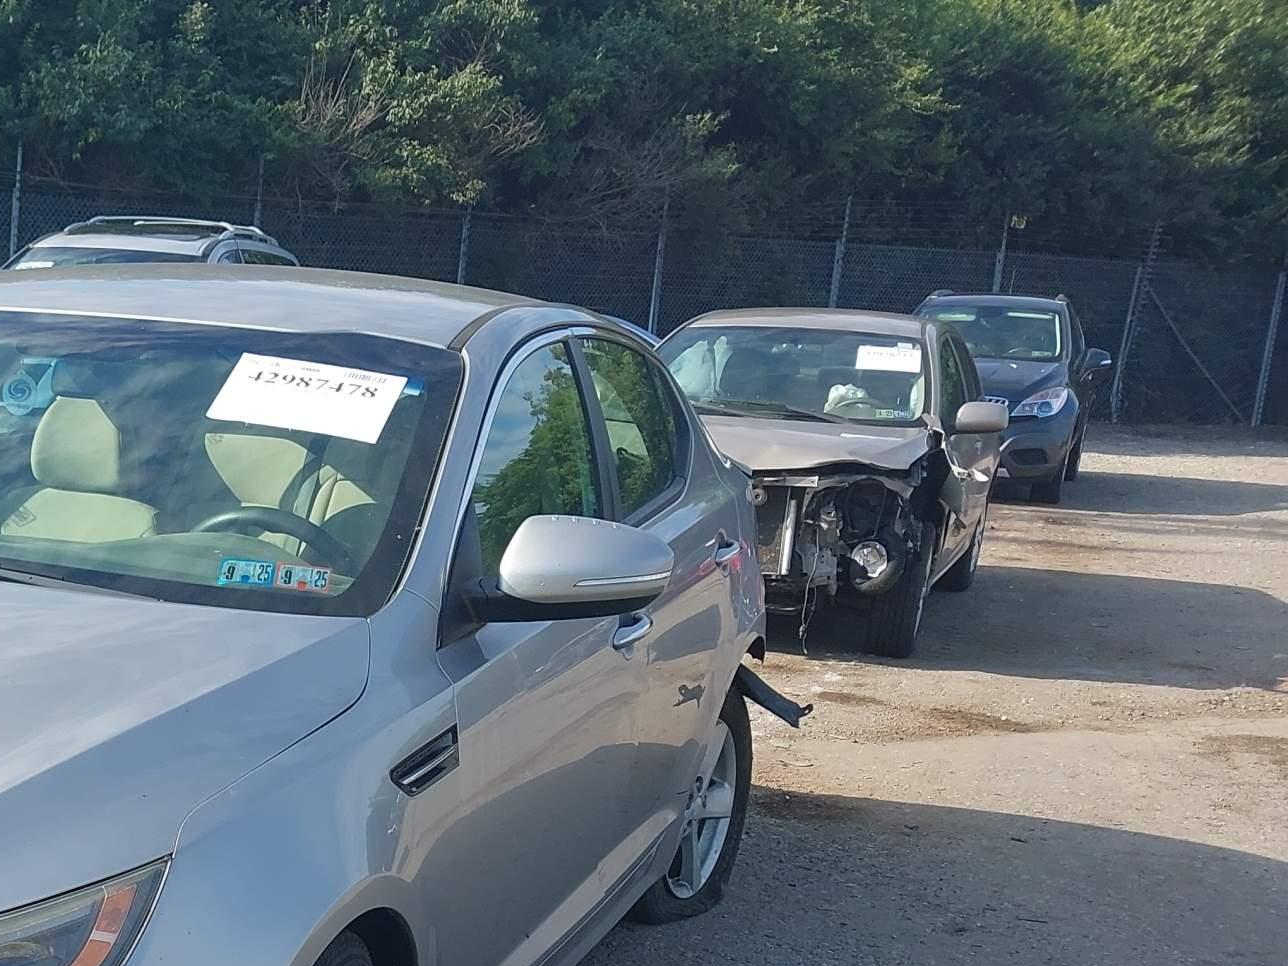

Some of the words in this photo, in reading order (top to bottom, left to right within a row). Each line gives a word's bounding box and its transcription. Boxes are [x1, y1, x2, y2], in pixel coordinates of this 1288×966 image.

[248, 370, 378, 398] 42987478
[257, 564, 272, 583] 25
[314, 570, 329, 588] 25
